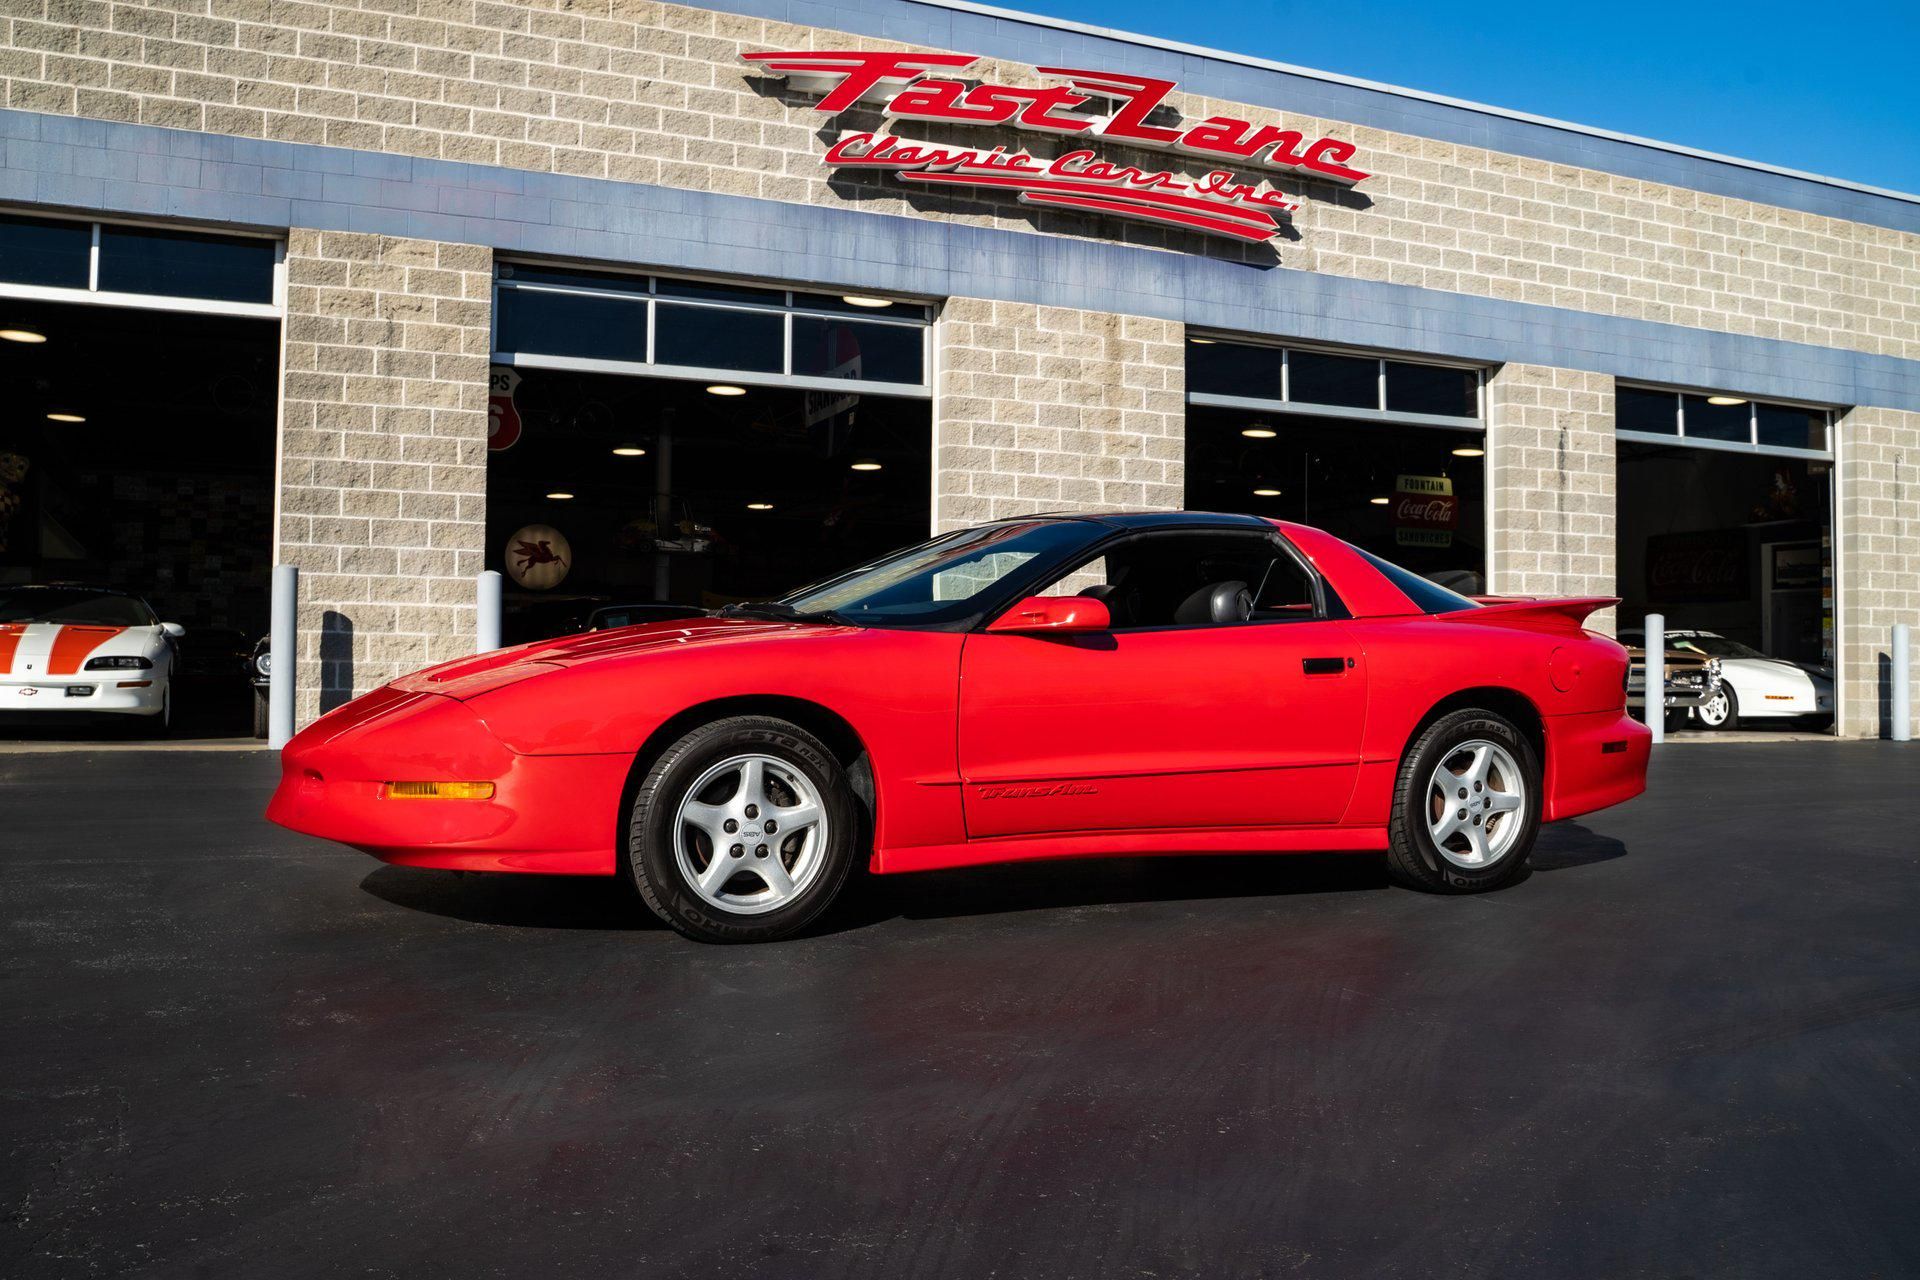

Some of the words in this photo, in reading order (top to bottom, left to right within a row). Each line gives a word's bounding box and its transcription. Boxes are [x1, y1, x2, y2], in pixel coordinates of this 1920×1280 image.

[740, 51, 1092, 136] Fast
[1036, 66, 1372, 185] Lane
[821, 132, 1045, 175] Classic
[1046, 150, 1190, 191] Cars
[1404, 479, 1444, 491] FOUNTAIN
[1397, 498, 1454, 522] Coca-Cola
